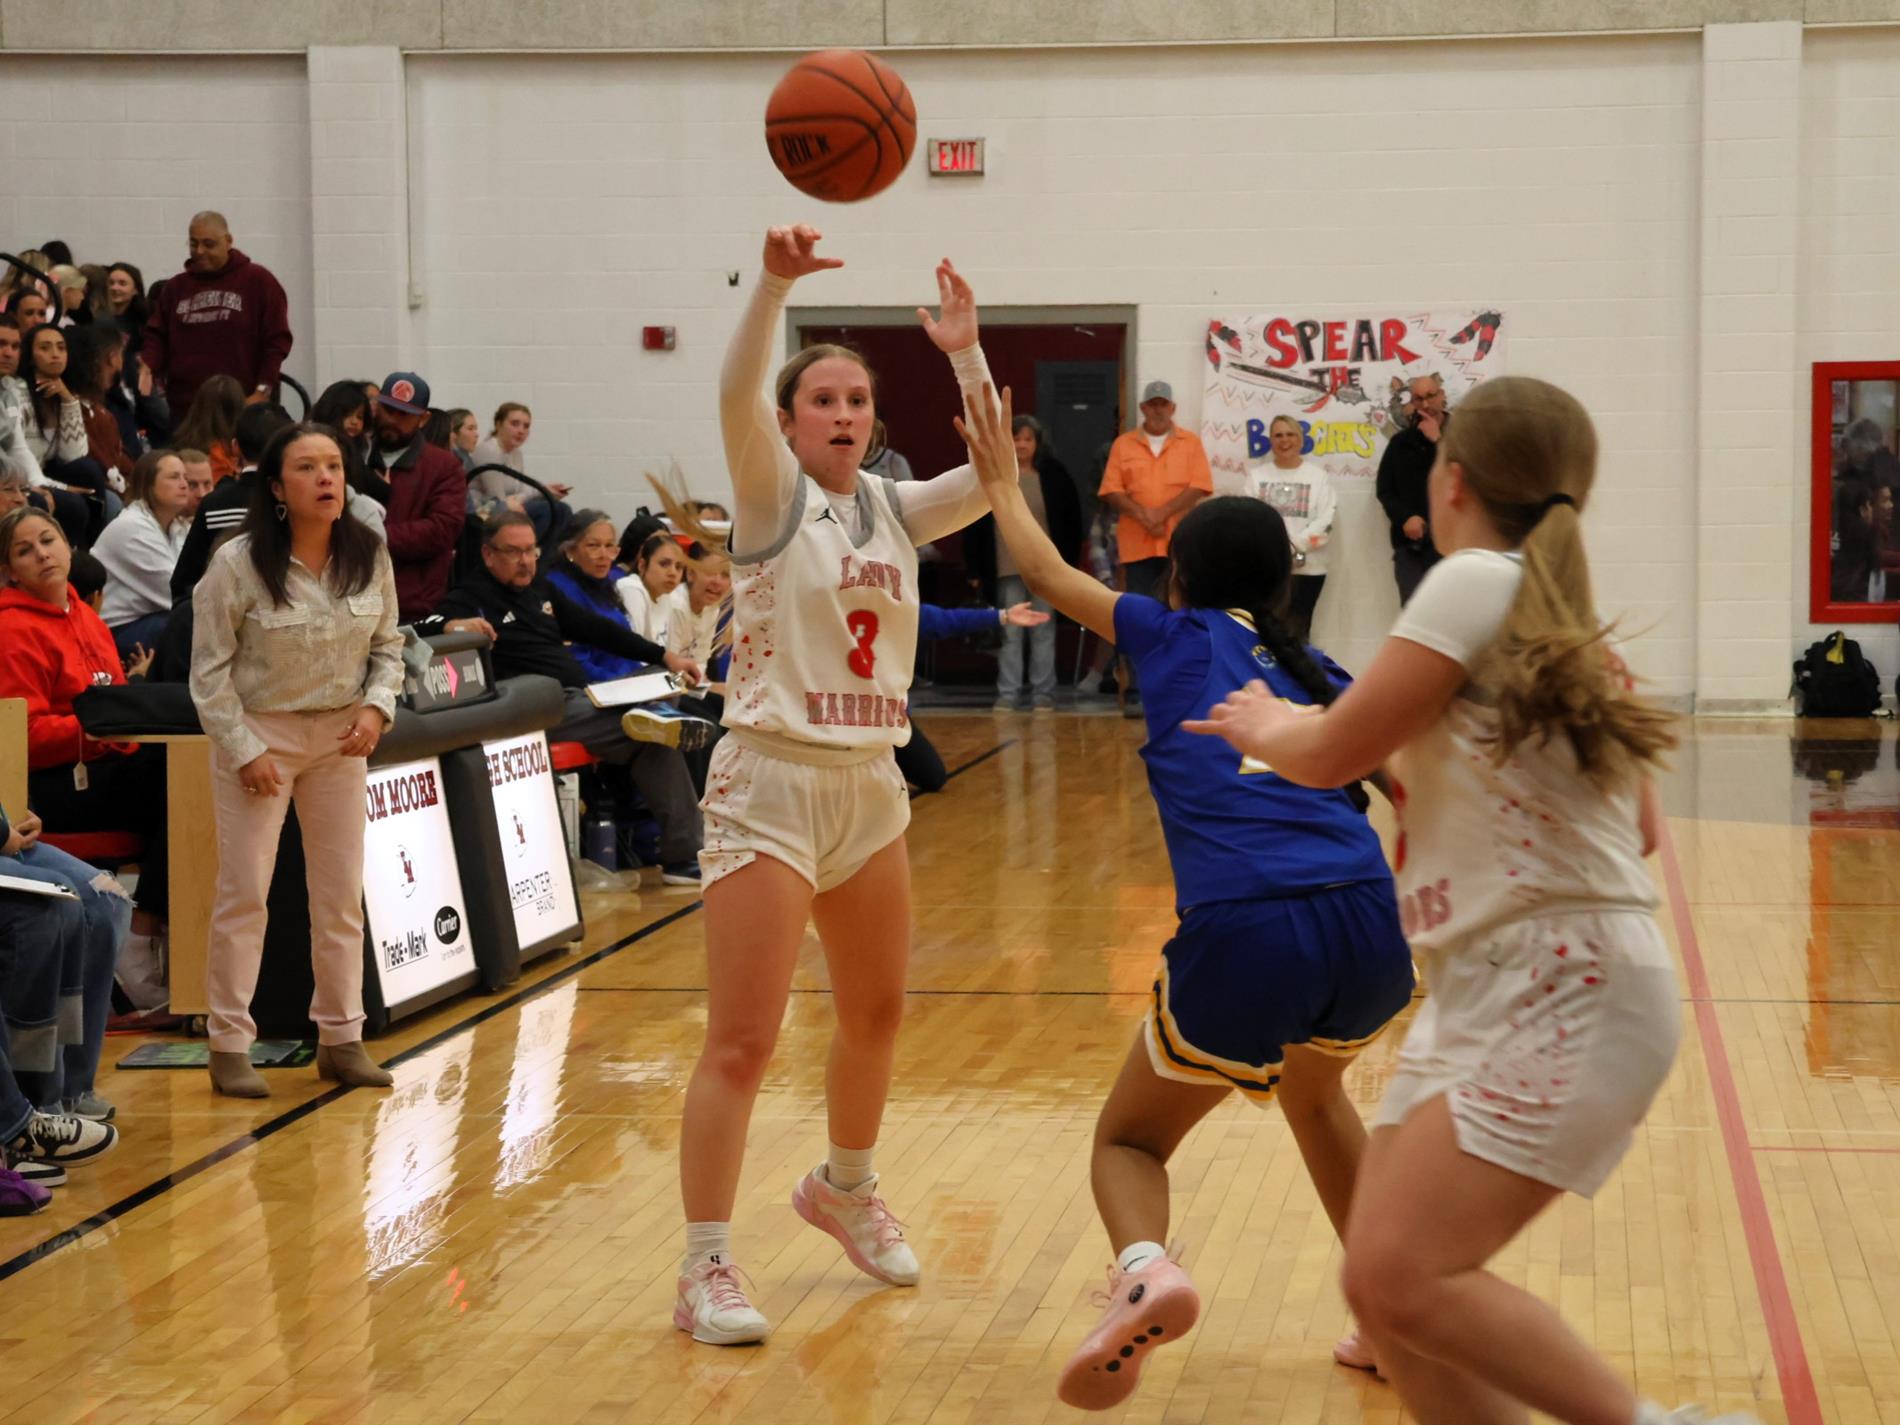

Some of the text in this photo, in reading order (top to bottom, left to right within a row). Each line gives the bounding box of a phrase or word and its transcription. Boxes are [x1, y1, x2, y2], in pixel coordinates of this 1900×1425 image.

[937, 141, 977, 171] EXIT
[1264, 317, 1423, 369] SPEAR
[1309, 366, 1362, 392] THE
[1246, 417, 1378, 459] BBCATS
[839, 555, 903, 602] LADY
[846, 608, 880, 681] 3
[502, 741, 548, 782] SCHOOL
[366, 770, 438, 822] OM MOORE
